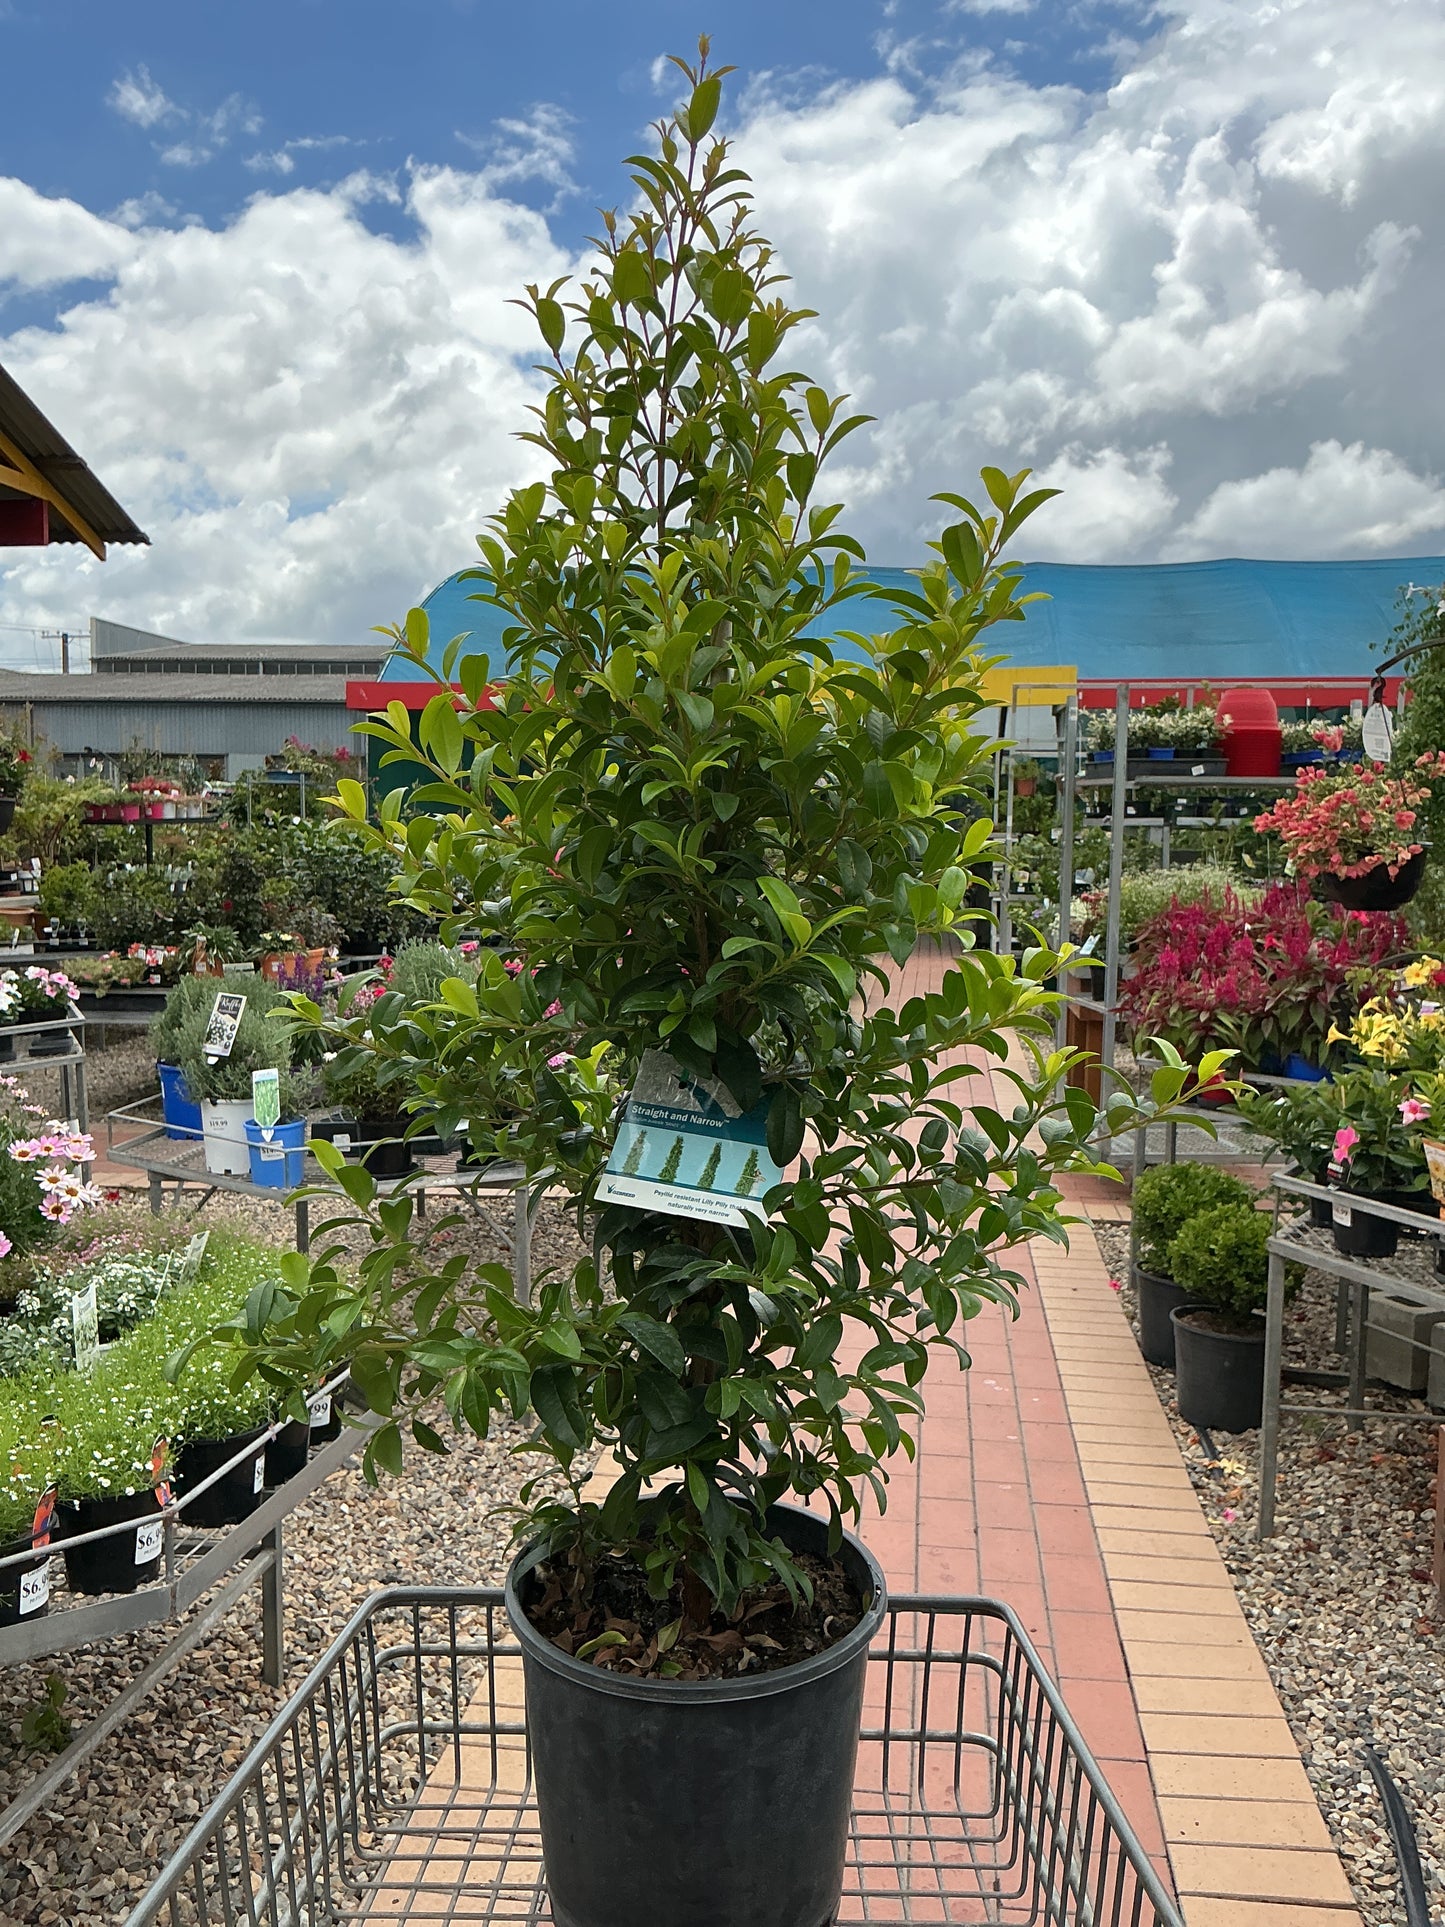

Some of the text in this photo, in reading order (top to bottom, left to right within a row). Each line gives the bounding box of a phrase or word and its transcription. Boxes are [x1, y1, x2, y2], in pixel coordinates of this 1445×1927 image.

[631, 1104, 669, 1119] Straight
[670, 1112, 688, 1122] and
[673, 1193, 701, 1203] resistant
[701, 1198, 714, 1207] Lilly
[667, 1201, 731, 1218] naturally very narrow
